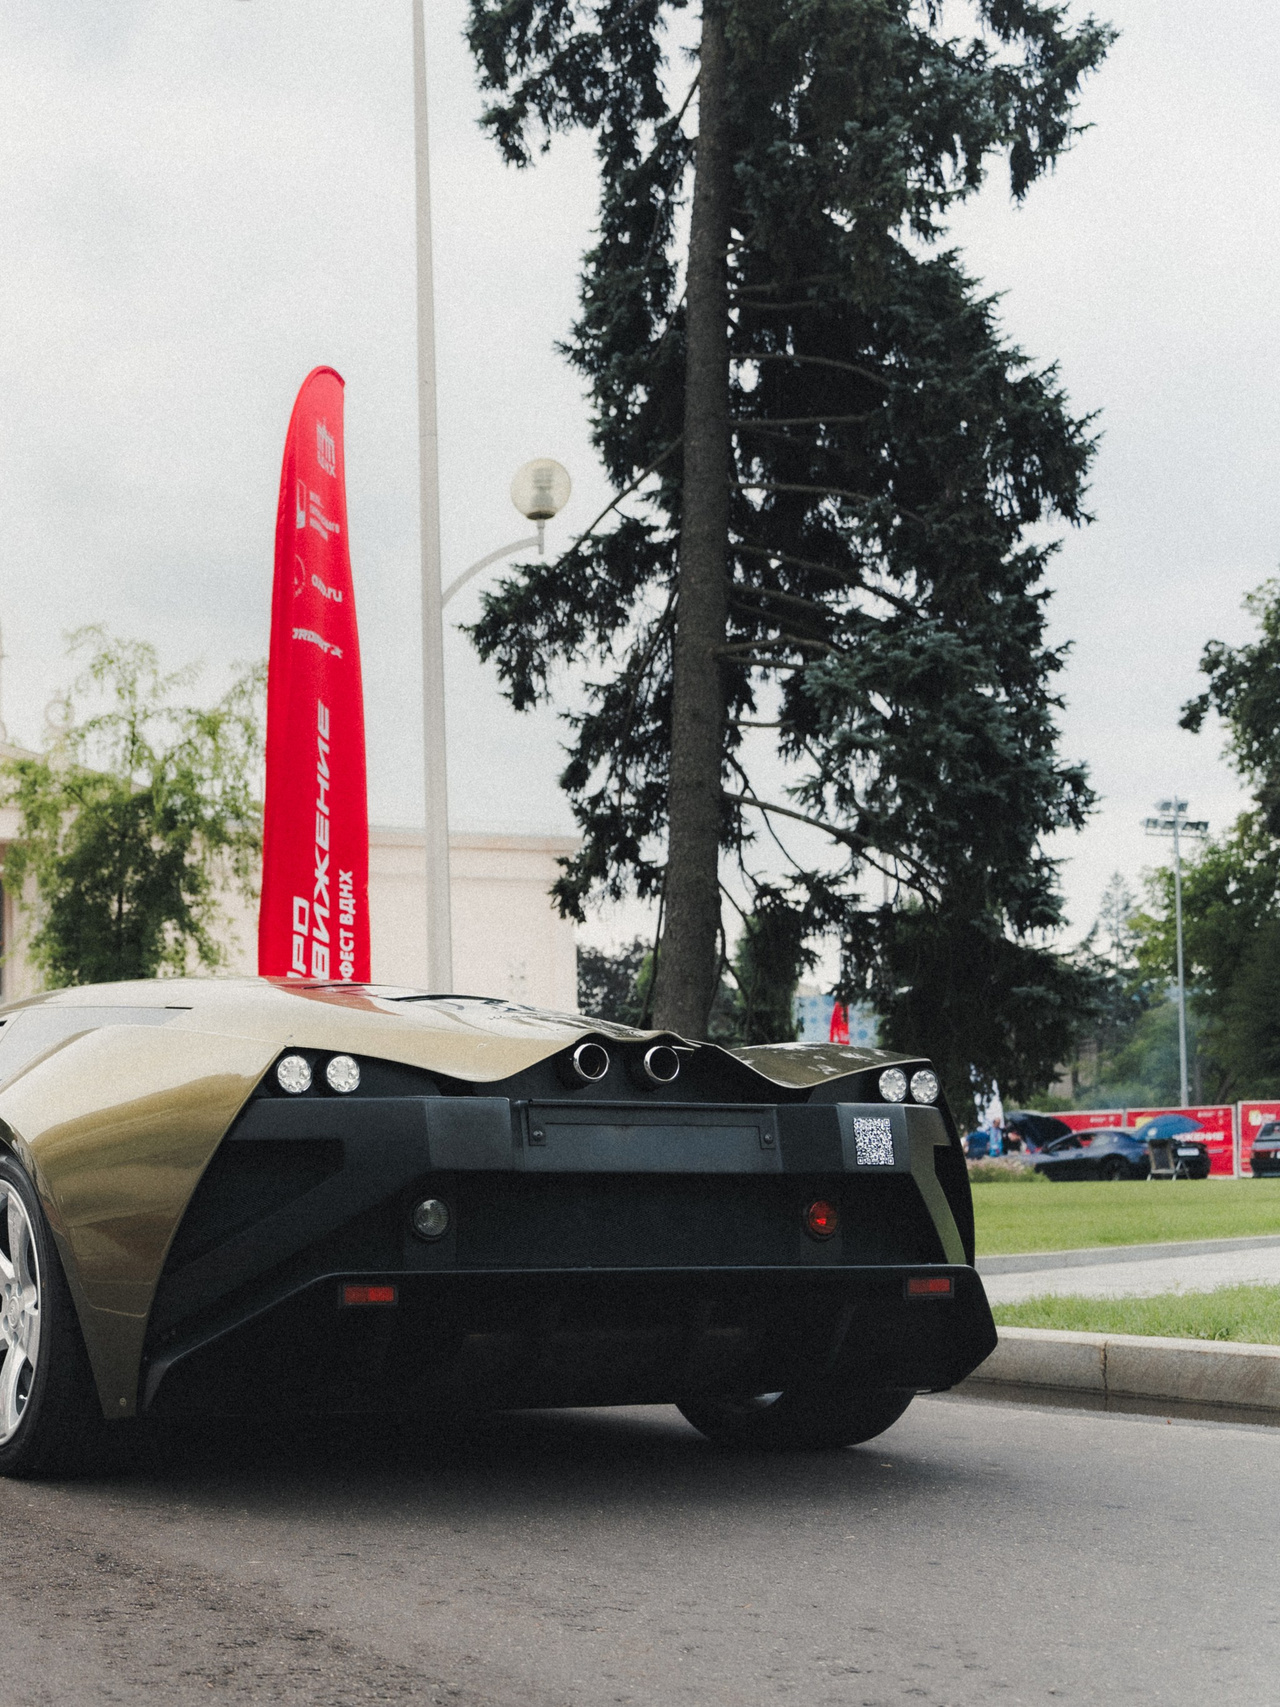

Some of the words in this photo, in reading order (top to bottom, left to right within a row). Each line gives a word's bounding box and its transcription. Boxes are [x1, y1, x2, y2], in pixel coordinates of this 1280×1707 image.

[311, 698, 330, 981] ВИЖЕНИЕ
[339, 868, 356, 926] ВДНХ
[286, 895, 310, 979] РО
[339, 928, 355, 981] ФЕСТ
